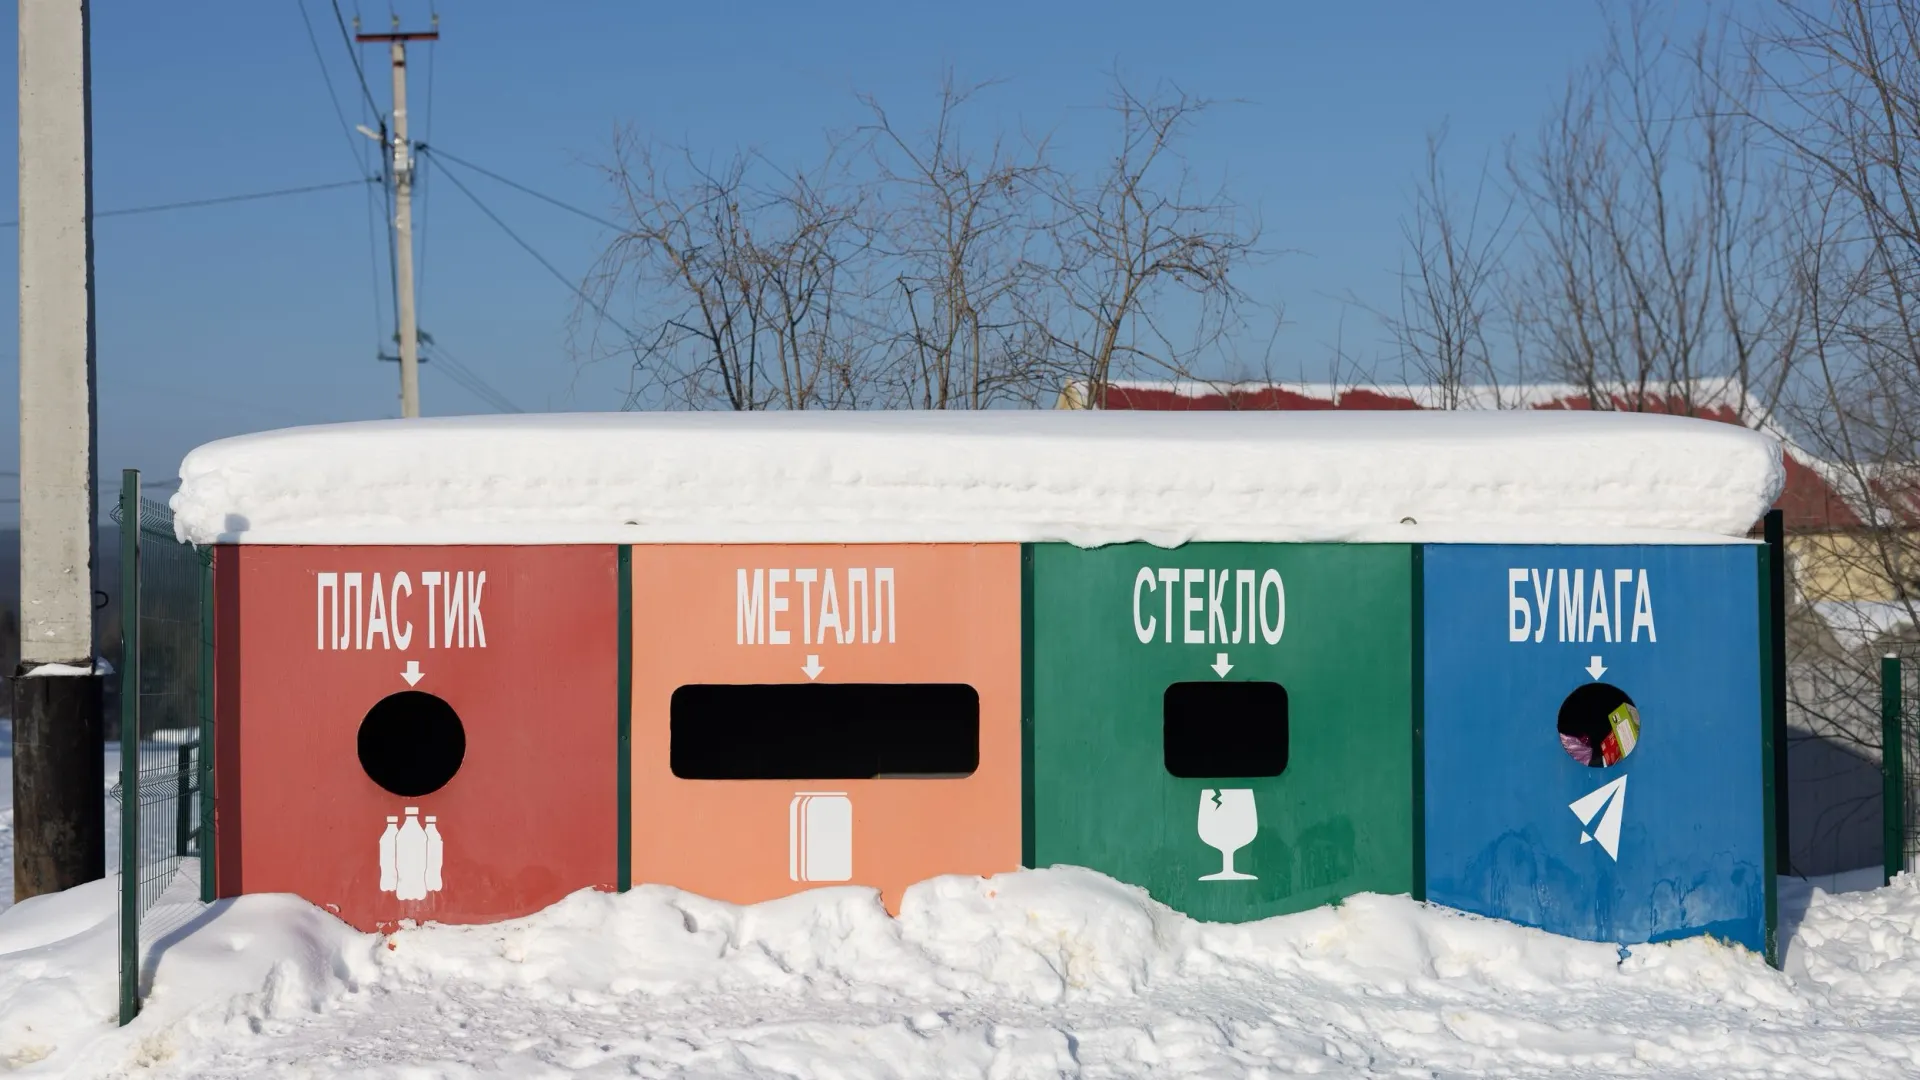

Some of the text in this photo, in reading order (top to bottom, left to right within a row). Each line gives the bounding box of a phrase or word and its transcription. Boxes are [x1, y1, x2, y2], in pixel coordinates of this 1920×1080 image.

[317, 570, 487, 651] ПЛАСТИК
[736, 567, 896, 645] МЕТАЛЛ
[1133, 566, 1286, 646] СТЕКЛО
[1508, 568, 1657, 643] БУМАГА
